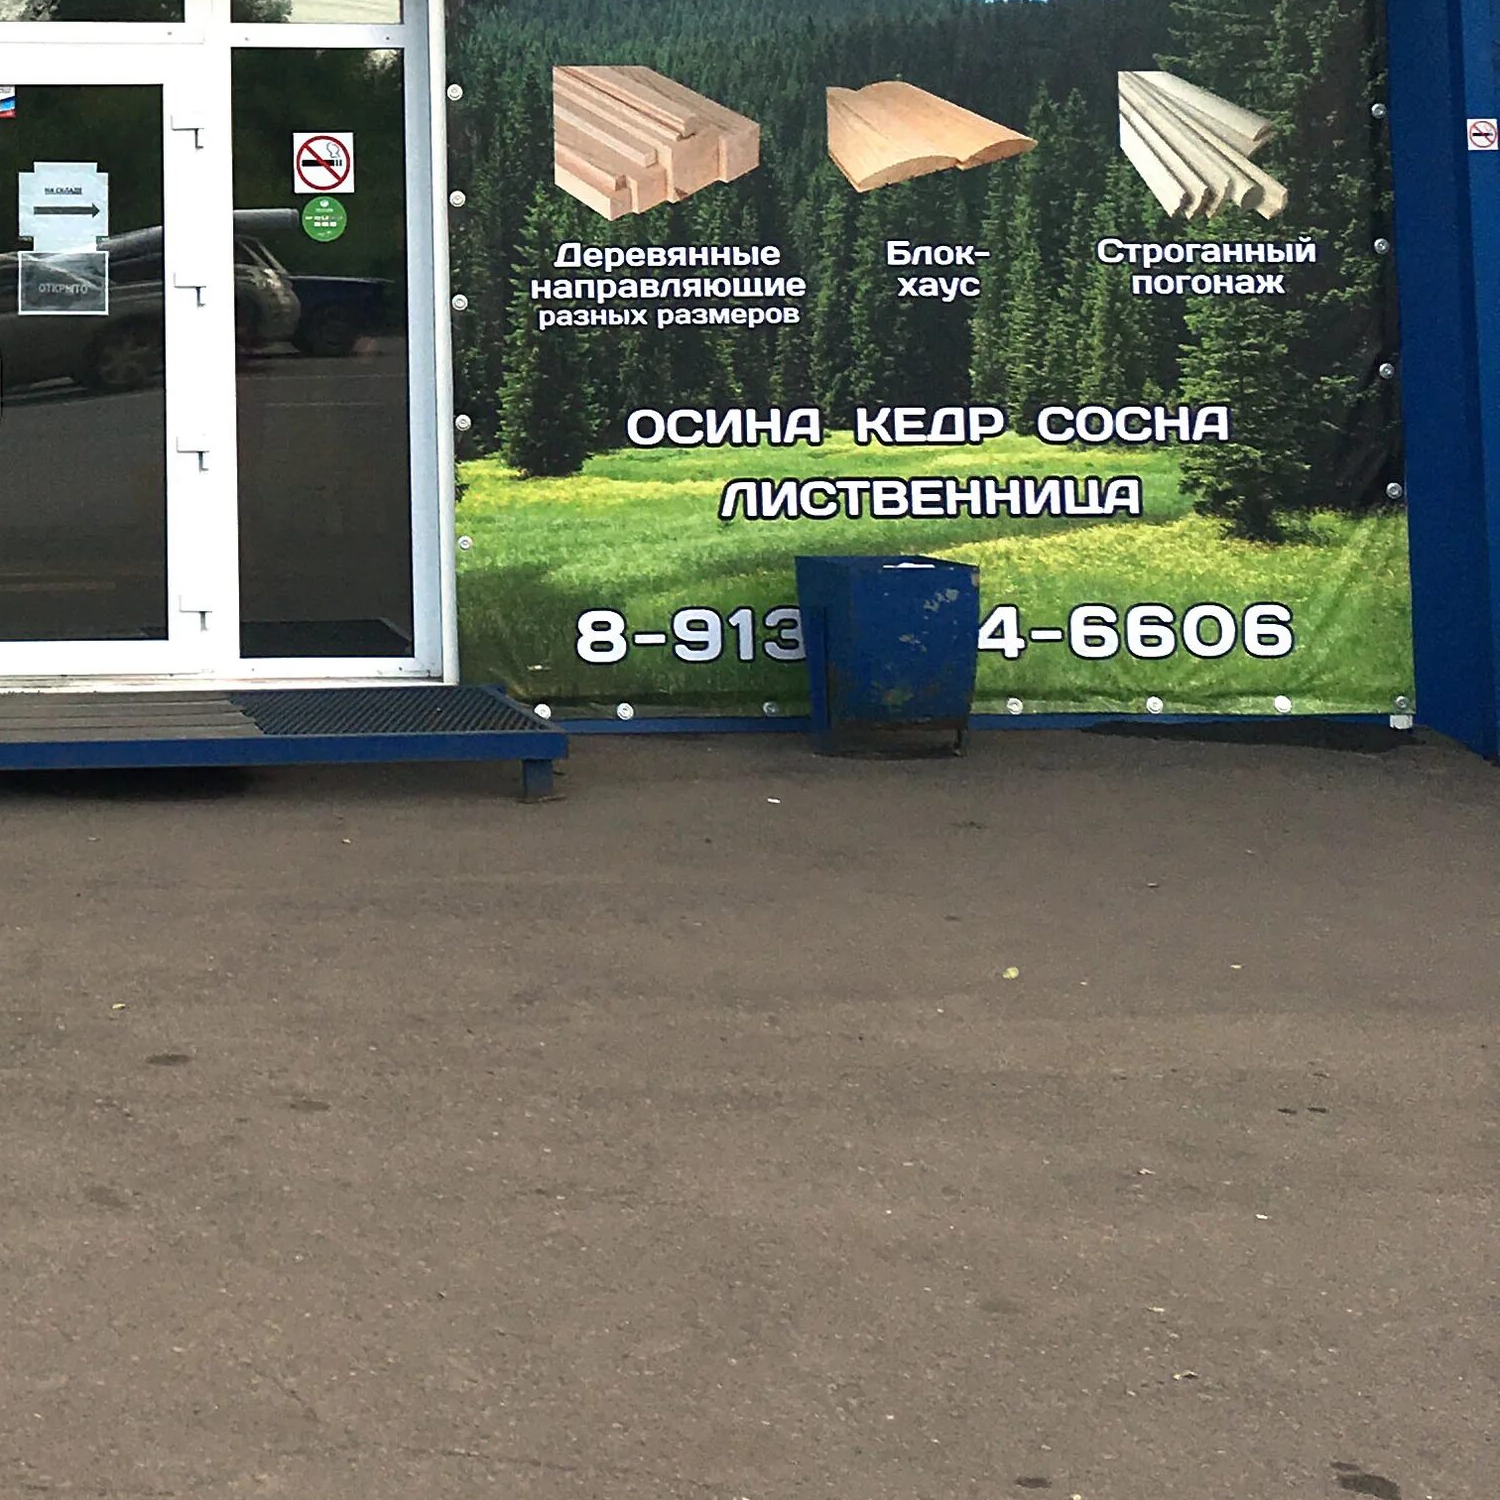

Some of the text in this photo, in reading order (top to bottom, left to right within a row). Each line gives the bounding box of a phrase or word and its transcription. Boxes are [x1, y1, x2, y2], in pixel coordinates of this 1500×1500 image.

[553, 241, 782, 269] Деревянные
[885, 239, 991, 267] Блок-
[1096, 236, 1317, 269] Строганный
[38, 282, 89, 295] ОТКРЫТО
[530, 275, 807, 302] направляющие
[896, 275, 981, 303] хаус
[1131, 273, 1287, 297] погонаж
[538, 306, 801, 331] разных размеров
[626, 405, 1230, 445] ОСИНА КЕДР СОСНА
[720, 478, 1142, 520] ЛИСТВЕННИЦА
